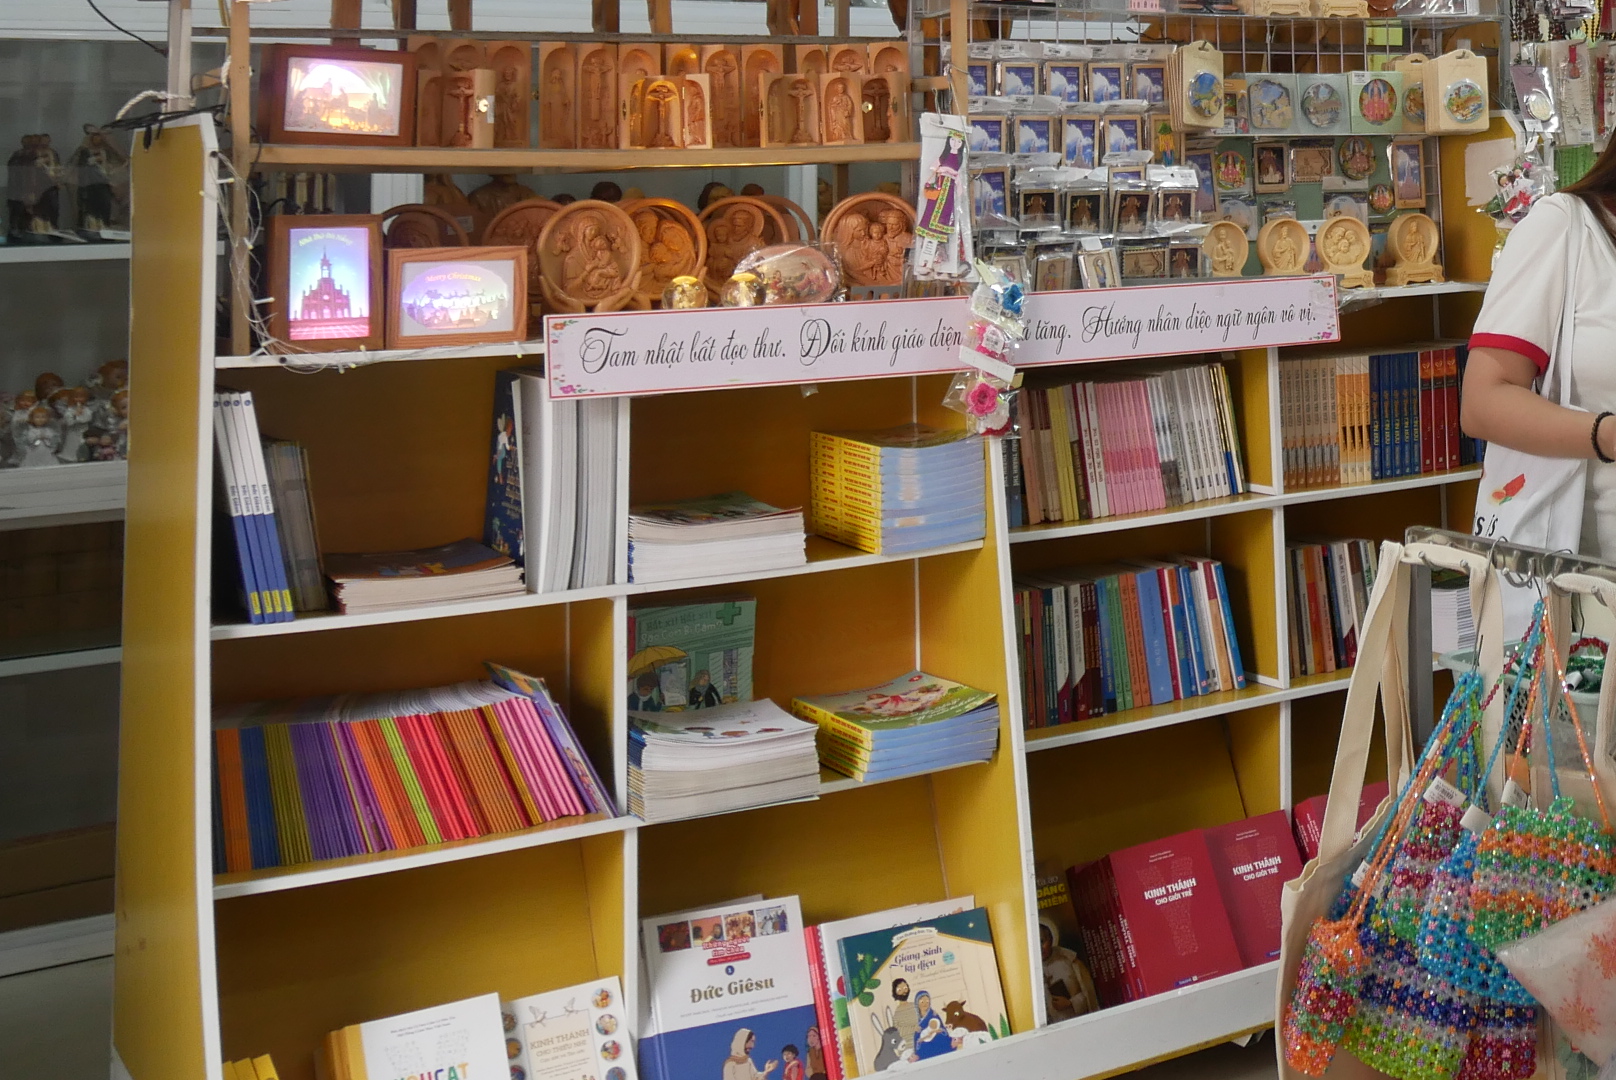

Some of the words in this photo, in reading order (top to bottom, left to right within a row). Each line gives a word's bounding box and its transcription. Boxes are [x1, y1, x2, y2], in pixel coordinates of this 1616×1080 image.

[425, 273, 447, 283] Merry
[447, 272, 481, 283] Christmas
[580, 328, 638, 374] Tam
[644, 333, 685, 369] nhật
[690, 331, 717, 363] bất
[720, 330, 749, 366] đọc
[753, 327, 786, 359] thư.
[799, 318, 846, 366] Đối
[850, 321, 888, 352] kính
[890, 326, 926, 367] giáo
[929, 318, 964, 352] diện
[1036, 320, 1072, 355] tăng.
[1081, 301, 1142, 350] Hướng
[1147, 304, 1181, 333] nhân
[1185, 302, 1212, 334] diệc
[1216, 309, 1242, 342] ngữ
[1246, 305, 1276, 340] ngôn
[1280, 303, 1295, 322] vô
[1299, 302, 1317, 326] vị.
[1233, 864, 1253, 876] KINH
[1253, 855, 1282, 871] THÁNH
[1243, 874, 1256, 882] CHO
[1144, 889, 1167, 900] KINH
[1167, 877, 1197, 896] THÁNH
[1155, 896, 1169, 906] CHO
[1168, 893, 1182, 903] GIỚI
[690, 983, 724, 1004] Đức
[727, 977, 775, 996] Giêsu
[530, 1037, 555, 1050] KINH
